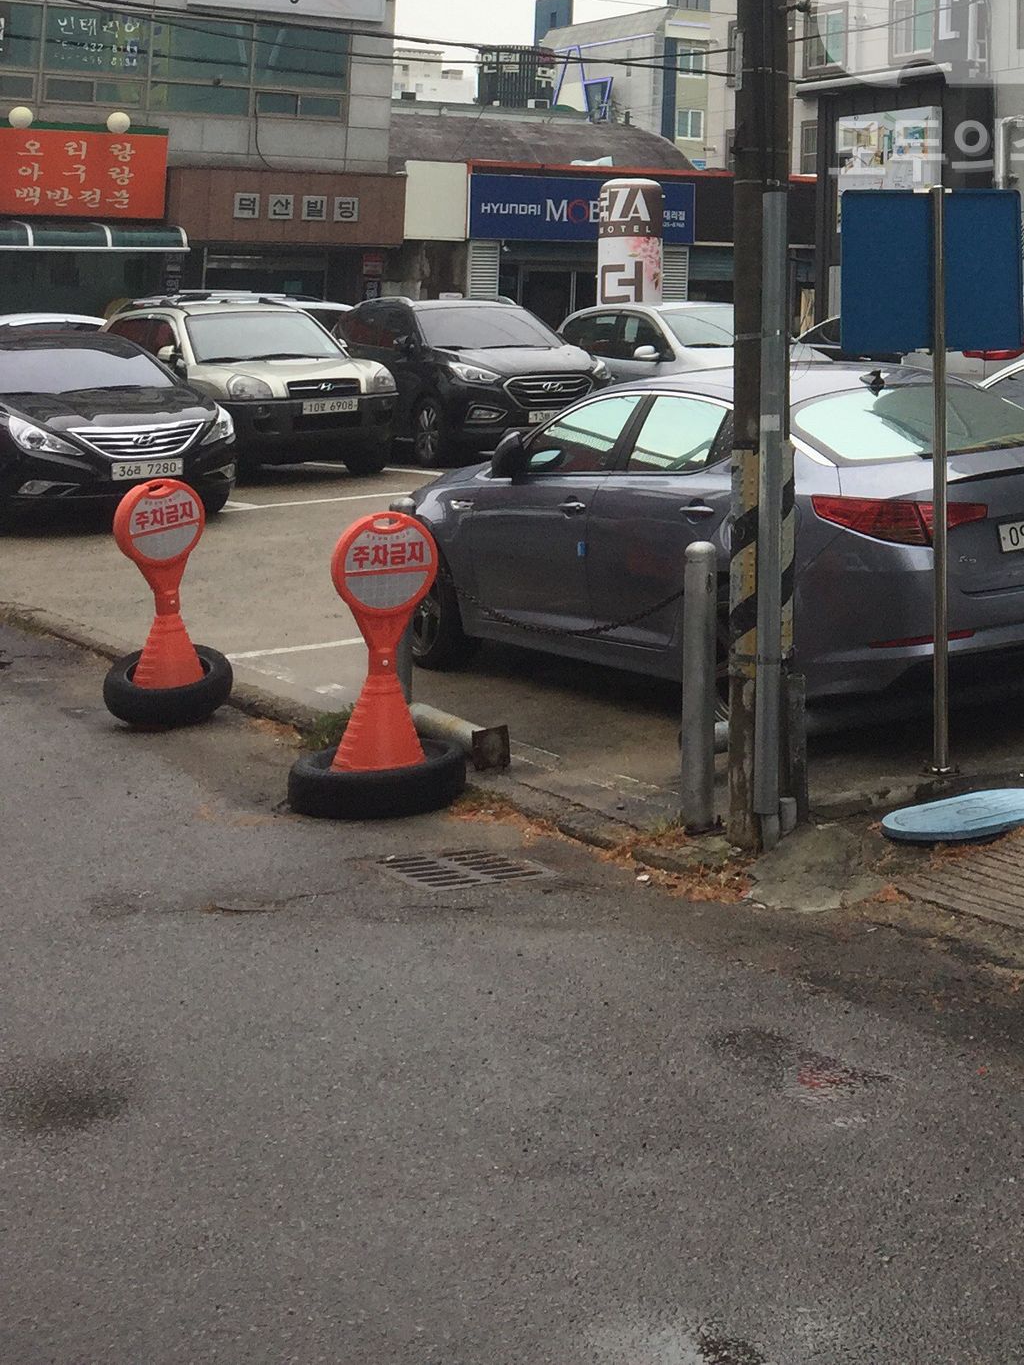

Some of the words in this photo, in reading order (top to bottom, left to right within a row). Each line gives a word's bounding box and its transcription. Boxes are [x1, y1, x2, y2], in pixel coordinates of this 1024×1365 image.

[16, 139, 136, 162] 오리랑
[17, 162, 135, 186] 아구랑
[238, 197, 356, 219] 덕산빌딩
[481, 202, 541, 216] HYUNDAI
[545, 199, 601, 224] MOB
[147, 462, 177, 475] 7280
[135, 500, 194, 531] 주차금지
[352, 541, 425, 570] 주차금지
